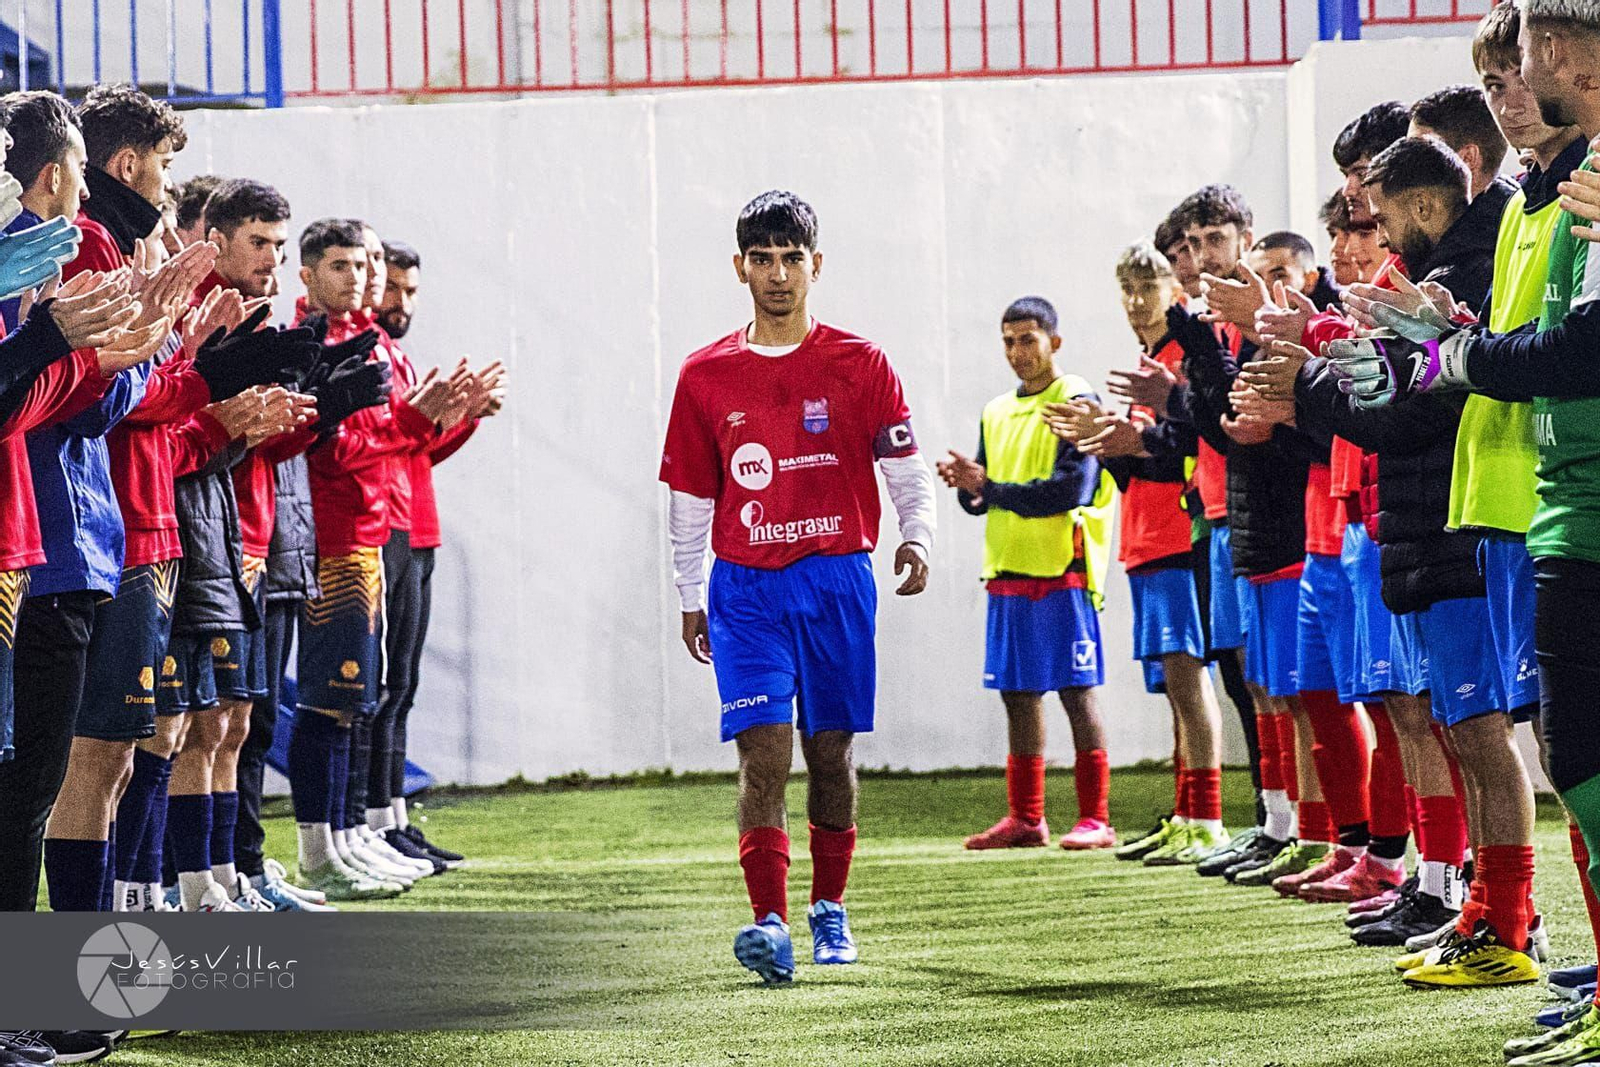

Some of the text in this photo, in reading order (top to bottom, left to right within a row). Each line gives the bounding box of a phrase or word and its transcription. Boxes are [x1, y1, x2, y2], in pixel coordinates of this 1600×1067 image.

[889, 424, 912, 447] C
[778, 453, 839, 467] MAXIMETAL
[749, 514, 843, 544] integrasur
